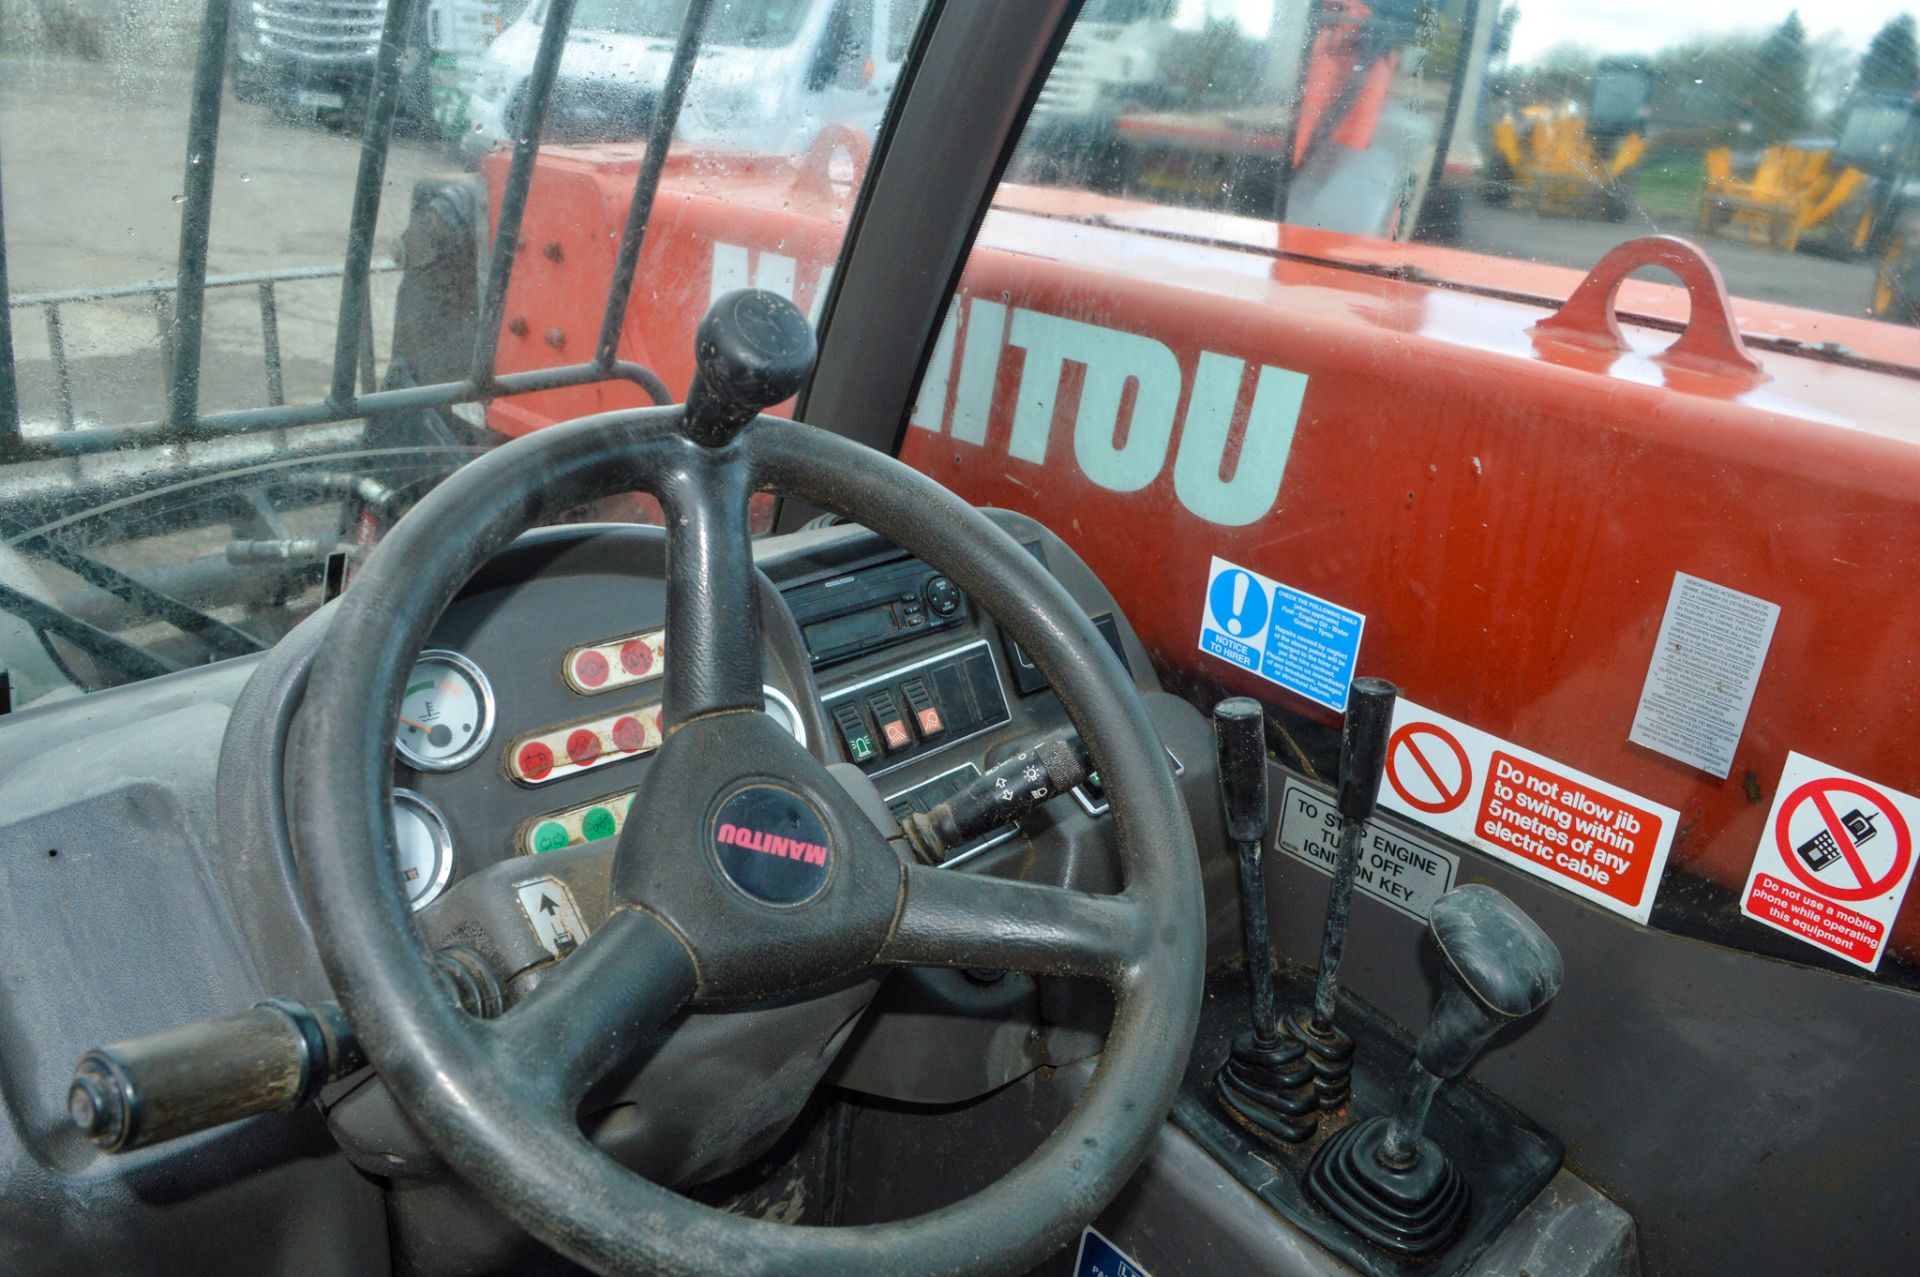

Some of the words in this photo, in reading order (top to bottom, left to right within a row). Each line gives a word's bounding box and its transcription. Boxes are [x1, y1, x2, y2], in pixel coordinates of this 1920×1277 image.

[1274, 624, 1296, 638] Repairs
[1296, 634, 1317, 647] caused
[1317, 642, 1326, 651] by
[1326, 646, 1347, 660] neglect
[1281, 605, 1294, 615] Fuel
[1298, 612, 1318, 626] Engine
[1318, 620, 1327, 629] Oil
[1331, 625, 1348, 637] Water
[1293, 617, 1313, 630] Grease
[1317, 627, 1334, 640] Tyres
[1209, 641, 1222, 653] TO
[1222, 646, 1251, 666] HIRER
[1215, 634, 1248, 655] NOTICE
[1492, 778, 1514, 802] to
[1514, 788, 1573, 830] swing
[1573, 813, 1636, 854] within
[1496, 758, 1526, 786] Do
[1525, 772, 1560, 800] not
[1559, 785, 1615, 823] allow
[1612, 808, 1642, 838] jib
[717, 823, 828, 868] MANITOU
[1295, 797, 1318, 820] TO
[1372, 834, 1440, 877] ENGINE
[1482, 815, 1555, 862] electric
[1554, 848, 1612, 887] cable
[1569, 833, 1593, 857] of
[1591, 846, 1631, 877] any
[1369, 852, 1404, 879] OFF
[1378, 876, 1414, 903] KEY
[1762, 877, 1779, 892] Do
[1781, 885, 1801, 901] not
[1802, 895, 1824, 911] use
[1825, 906, 1834, 915] a
[1835, 908, 1877, 934] mobile
[1752, 886, 1788, 910] phone
[1789, 902, 1820, 922] while
[1821, 916, 1879, 950] operating
[1768, 906, 1791, 923] this
[1791, 916, 1854, 953] equipment
